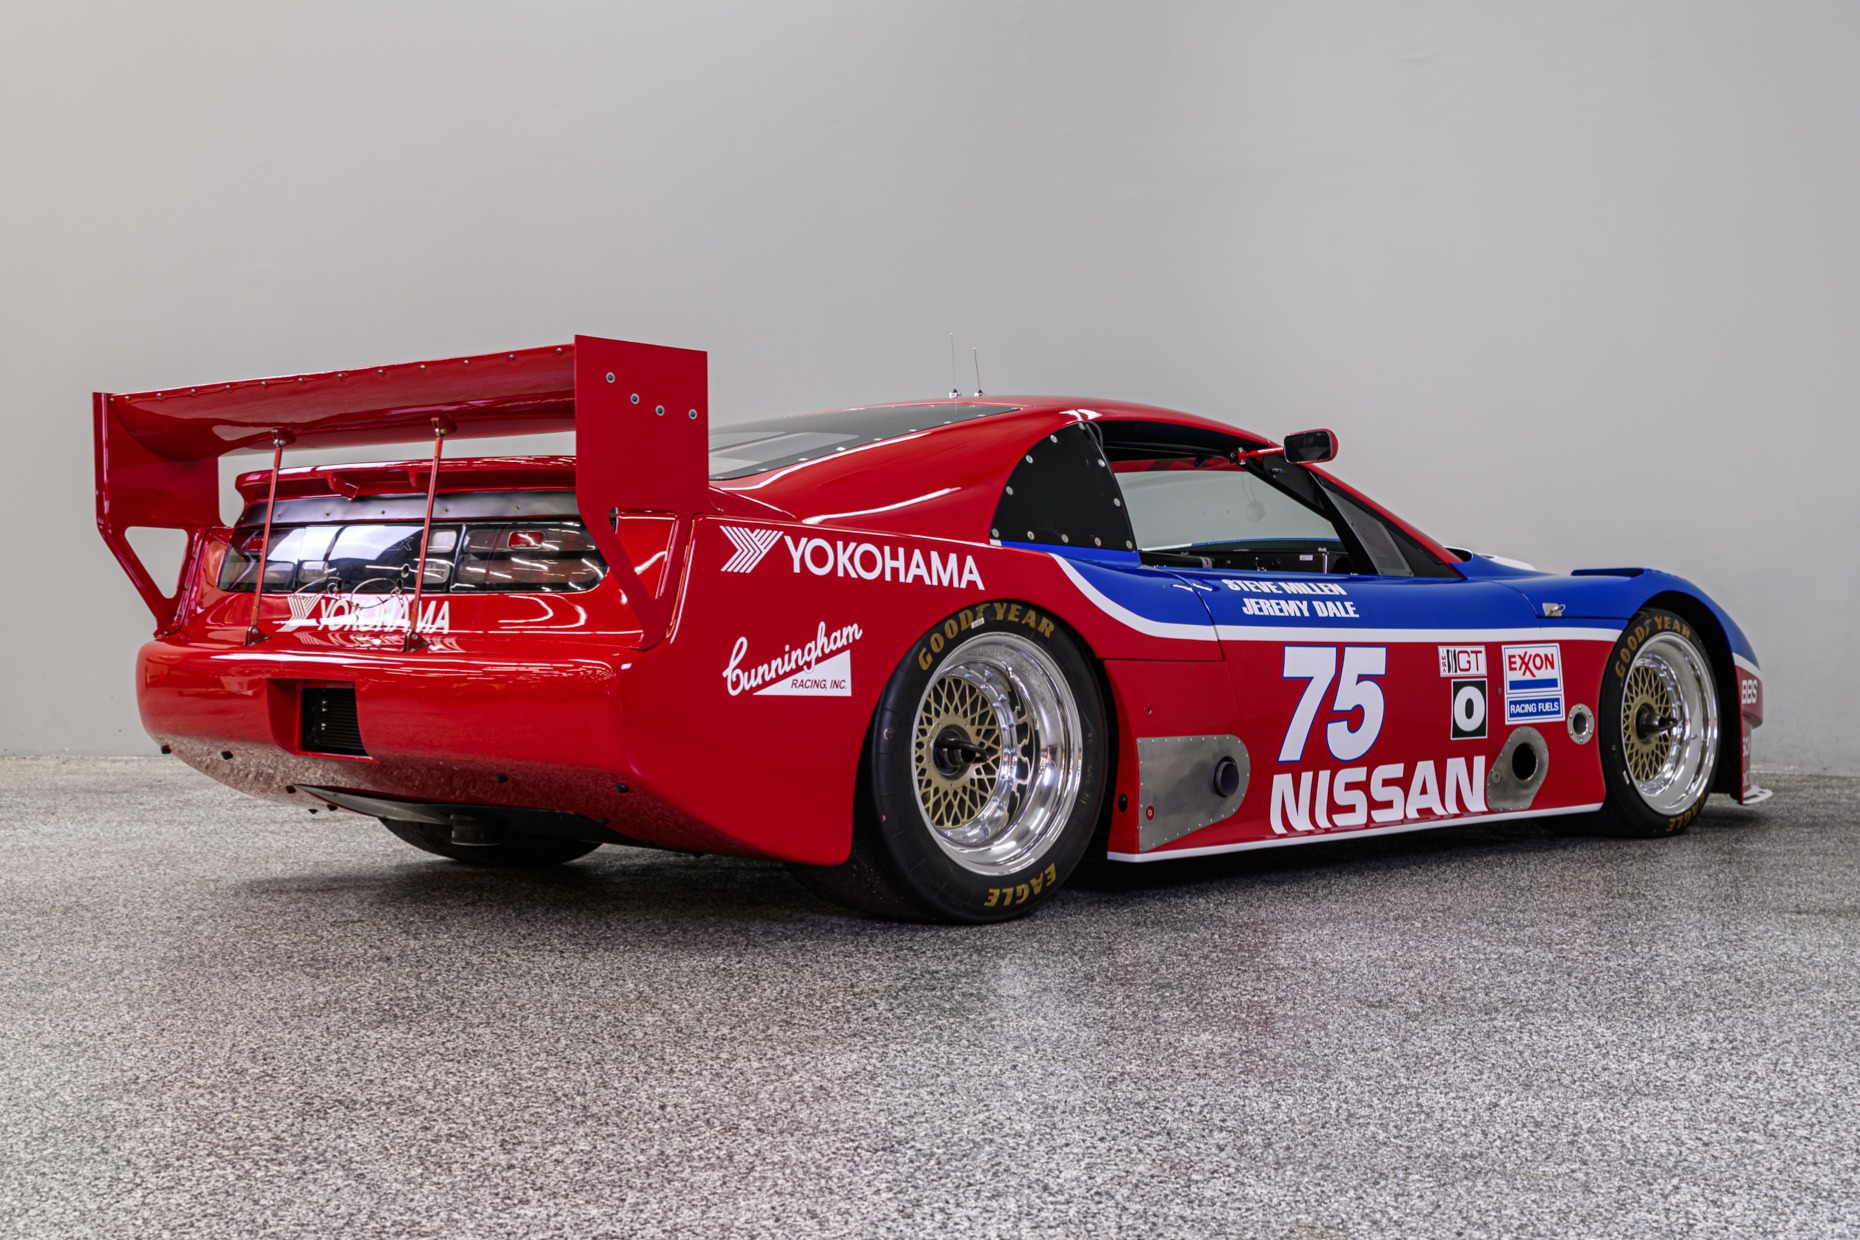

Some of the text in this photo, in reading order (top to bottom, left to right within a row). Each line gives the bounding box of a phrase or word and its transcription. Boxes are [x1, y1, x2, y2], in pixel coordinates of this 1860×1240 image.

[784, 535, 985, 591] YOKOHAMA
[1221, 579, 1348, 596] STEVE MILLEN
[1242, 598, 1359, 618] JEREMY DALE
[722, 621, 863, 696] Cunningham
[1508, 651, 1555, 678] EXXON
[829, 679, 847, 690] INC.
[1741, 679, 1757, 704] BBS
[1277, 644, 1387, 764] 75
[1510, 702, 1560, 714] RACING FUELS
[1269, 755, 1488, 835] NISSAN
[983, 863, 1056, 907] EAGLE
